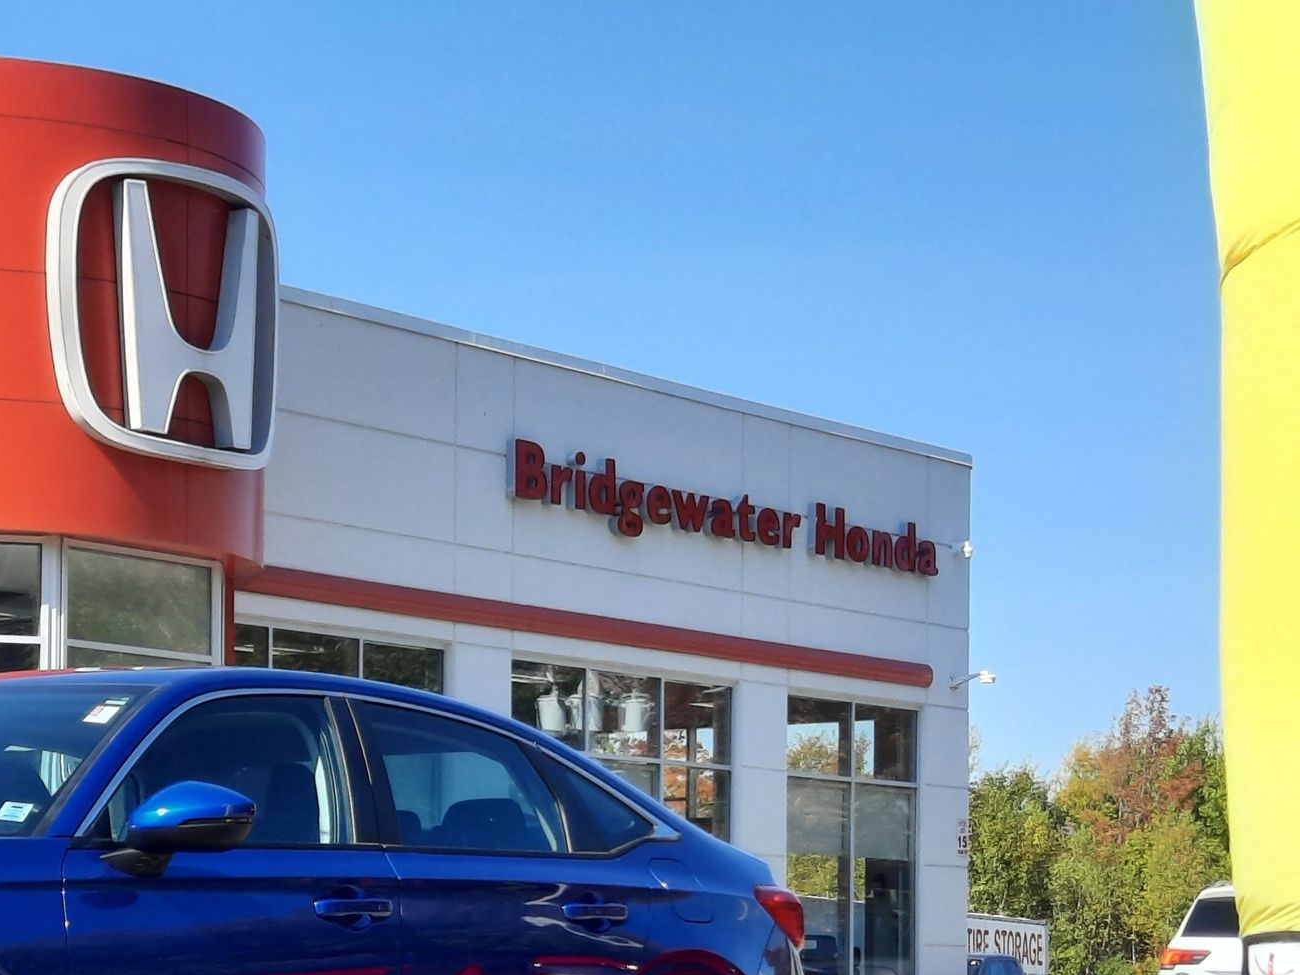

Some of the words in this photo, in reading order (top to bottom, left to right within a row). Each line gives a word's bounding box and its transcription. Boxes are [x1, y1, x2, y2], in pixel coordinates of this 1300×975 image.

[514, 438, 802, 550] Bridgewater
[813, 502, 939, 577] Honda
[994, 929, 1043, 967] STORAGE
